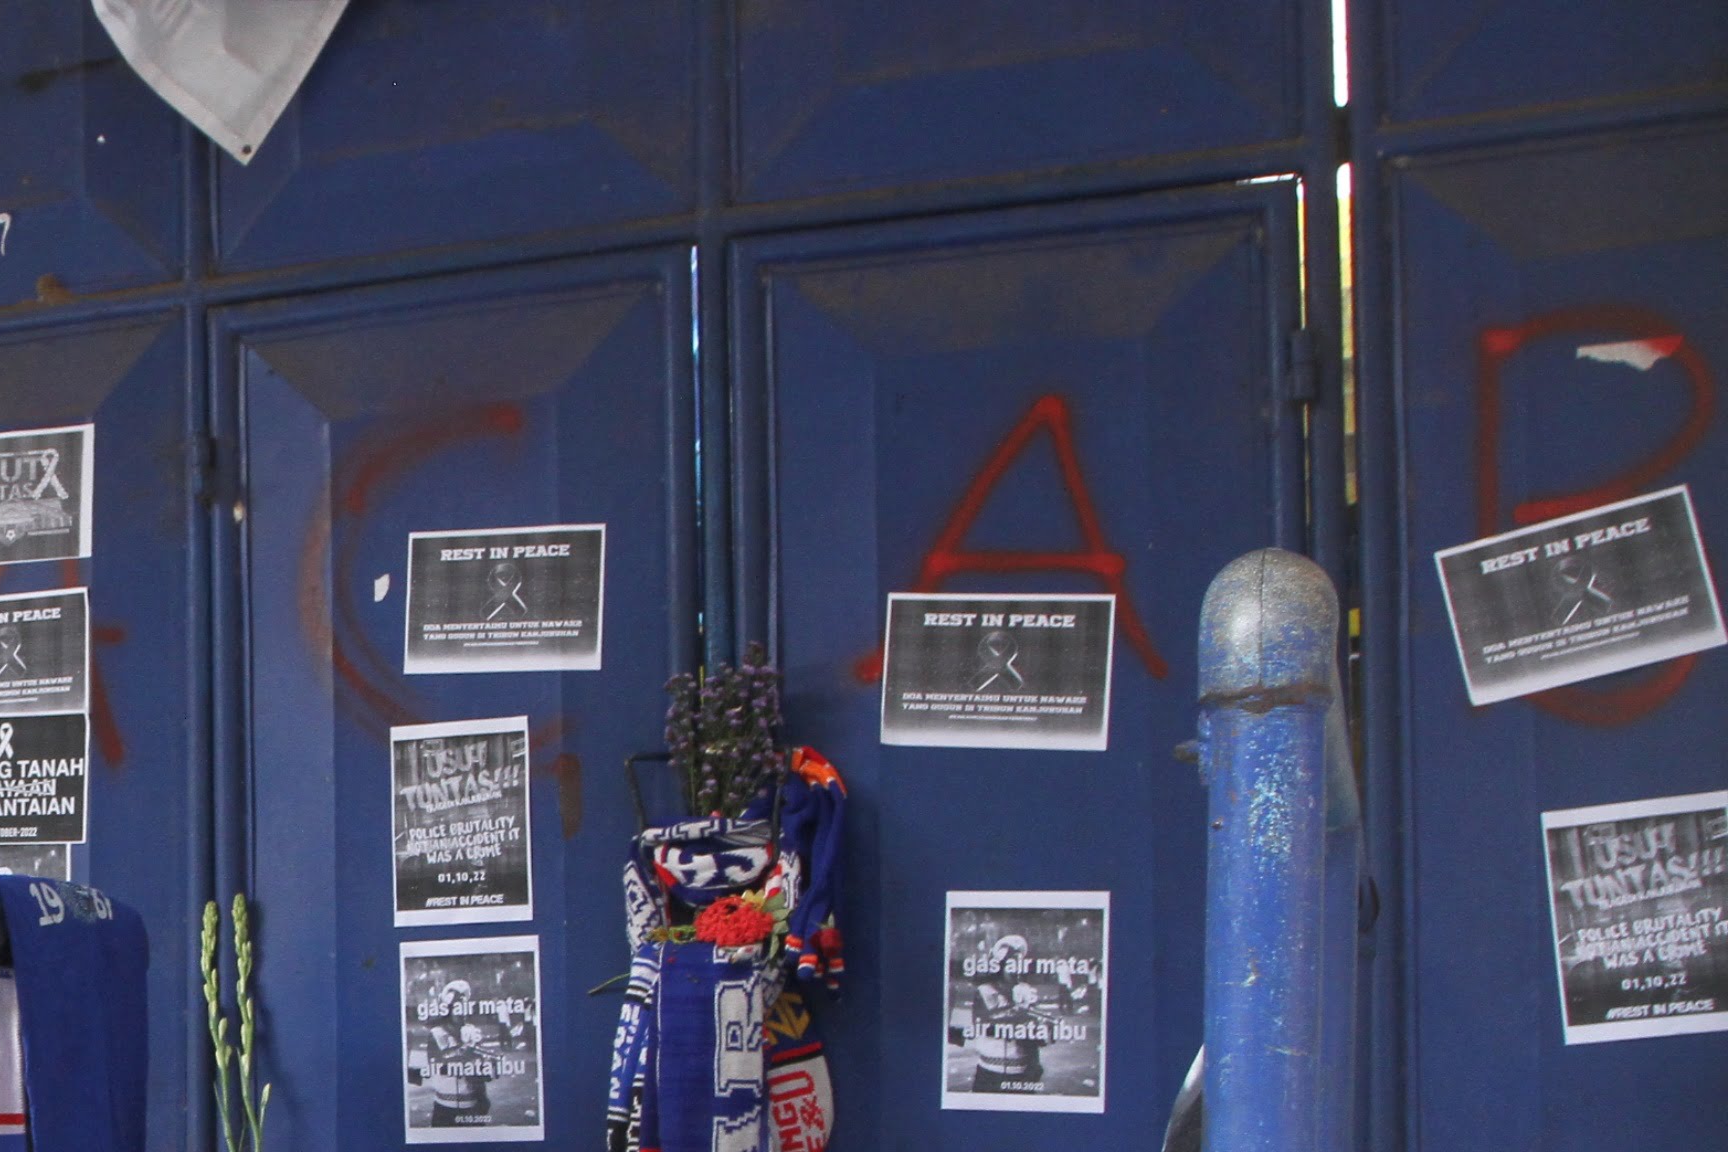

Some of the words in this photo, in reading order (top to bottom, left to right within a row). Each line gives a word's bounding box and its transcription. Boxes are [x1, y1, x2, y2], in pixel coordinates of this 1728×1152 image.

[440, 548, 485, 561] REST
[490, 547, 508, 559] IN
[513, 544, 570, 558] PEACE
[1481, 547, 1540, 575] REST
[1544, 539, 1571, 558] IN
[1575, 517, 1651, 550] PEACE
[12, 607, 62, 622] PEACE
[924, 613, 976, 626] REST
[981, 614, 1003, 627] IN
[1009, 614, 1075, 628] PEACE
[17, 758, 84, 777] TANAH
[409, 824, 446, 840] POLICE
[450, 815, 515, 835] BRUTALITY
[427, 850, 452, 864] WAS
[455, 848, 463, 860] A
[470, 893, 504, 905] PEACE
[1577, 921, 1629, 943] POLICE
[1632, 907, 1722, 936] BRUTALITY
[962, 954, 1000, 977] gas
[1004, 954, 1030, 974] air
[1036, 956, 1090, 974] mata
[1603, 950, 1639, 970] WAS
[1643, 950, 1654, 963] A
[417, 1001, 449, 1020] gas
[452, 999, 476, 1016] air
[479, 996, 524, 1015] mata
[1668, 999, 1714, 1014] PEACE
[962, 1018, 989, 1040] air
[994, 1021, 1048, 1040] mata
[1053, 1019, 1087, 1041] ibu
[420, 1057, 443, 1078] air
[447, 1058, 492, 1077] mata
[497, 1057, 526, 1075] ibu
